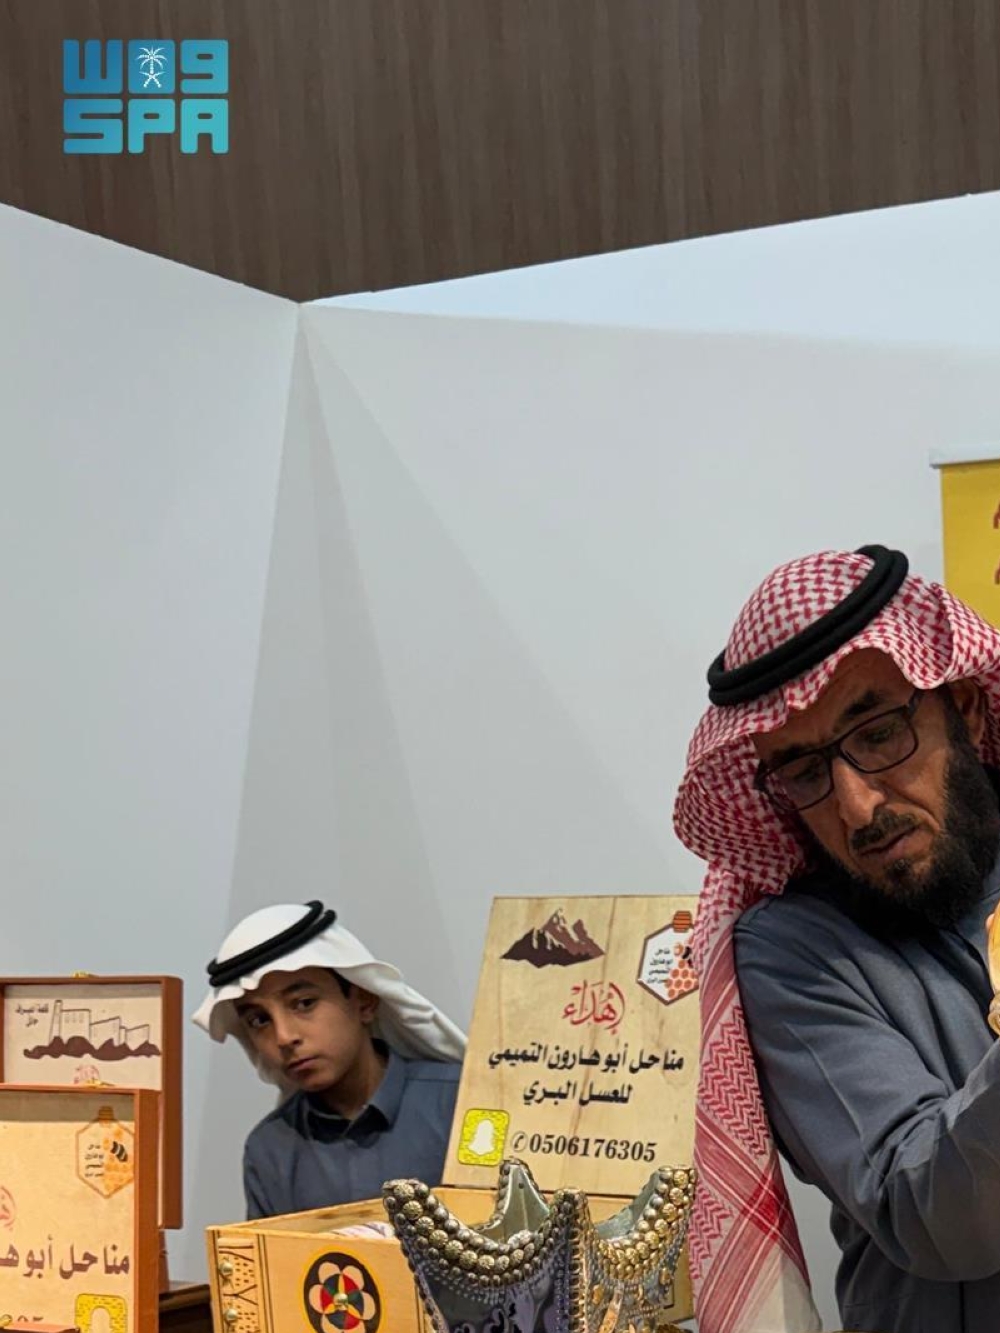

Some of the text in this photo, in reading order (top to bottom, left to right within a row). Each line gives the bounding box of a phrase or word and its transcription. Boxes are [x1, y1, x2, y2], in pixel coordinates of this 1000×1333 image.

[488, 1042, 548, 1069] التميمي
[523, 1080, 633, 1106] للعسل البري
[529, 1133, 657, 1162] 0506176305
